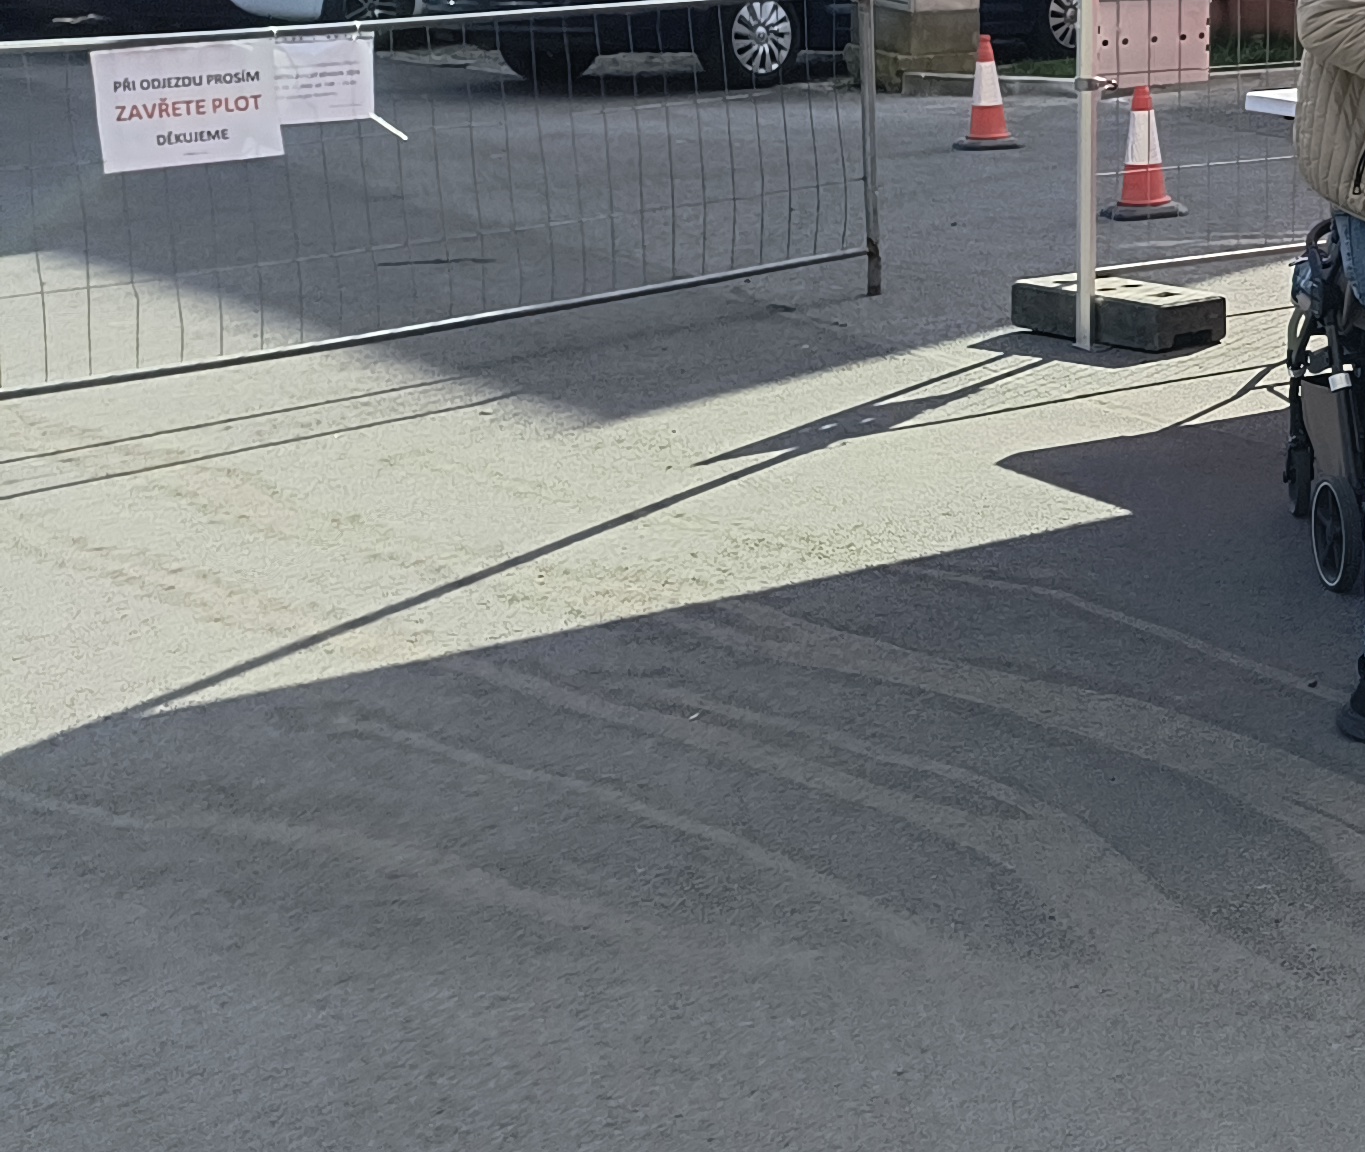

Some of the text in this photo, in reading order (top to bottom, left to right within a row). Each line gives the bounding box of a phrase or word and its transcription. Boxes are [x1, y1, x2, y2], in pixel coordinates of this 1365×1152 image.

[113, 77, 136, 93] PŘI
[139, 75, 203, 90] ODJEZDU
[206, 69, 260, 85] PROSÍM
[115, 94, 262, 122] ZAVŘETE PLOT
[156, 128, 230, 146] DĚKUJEME
